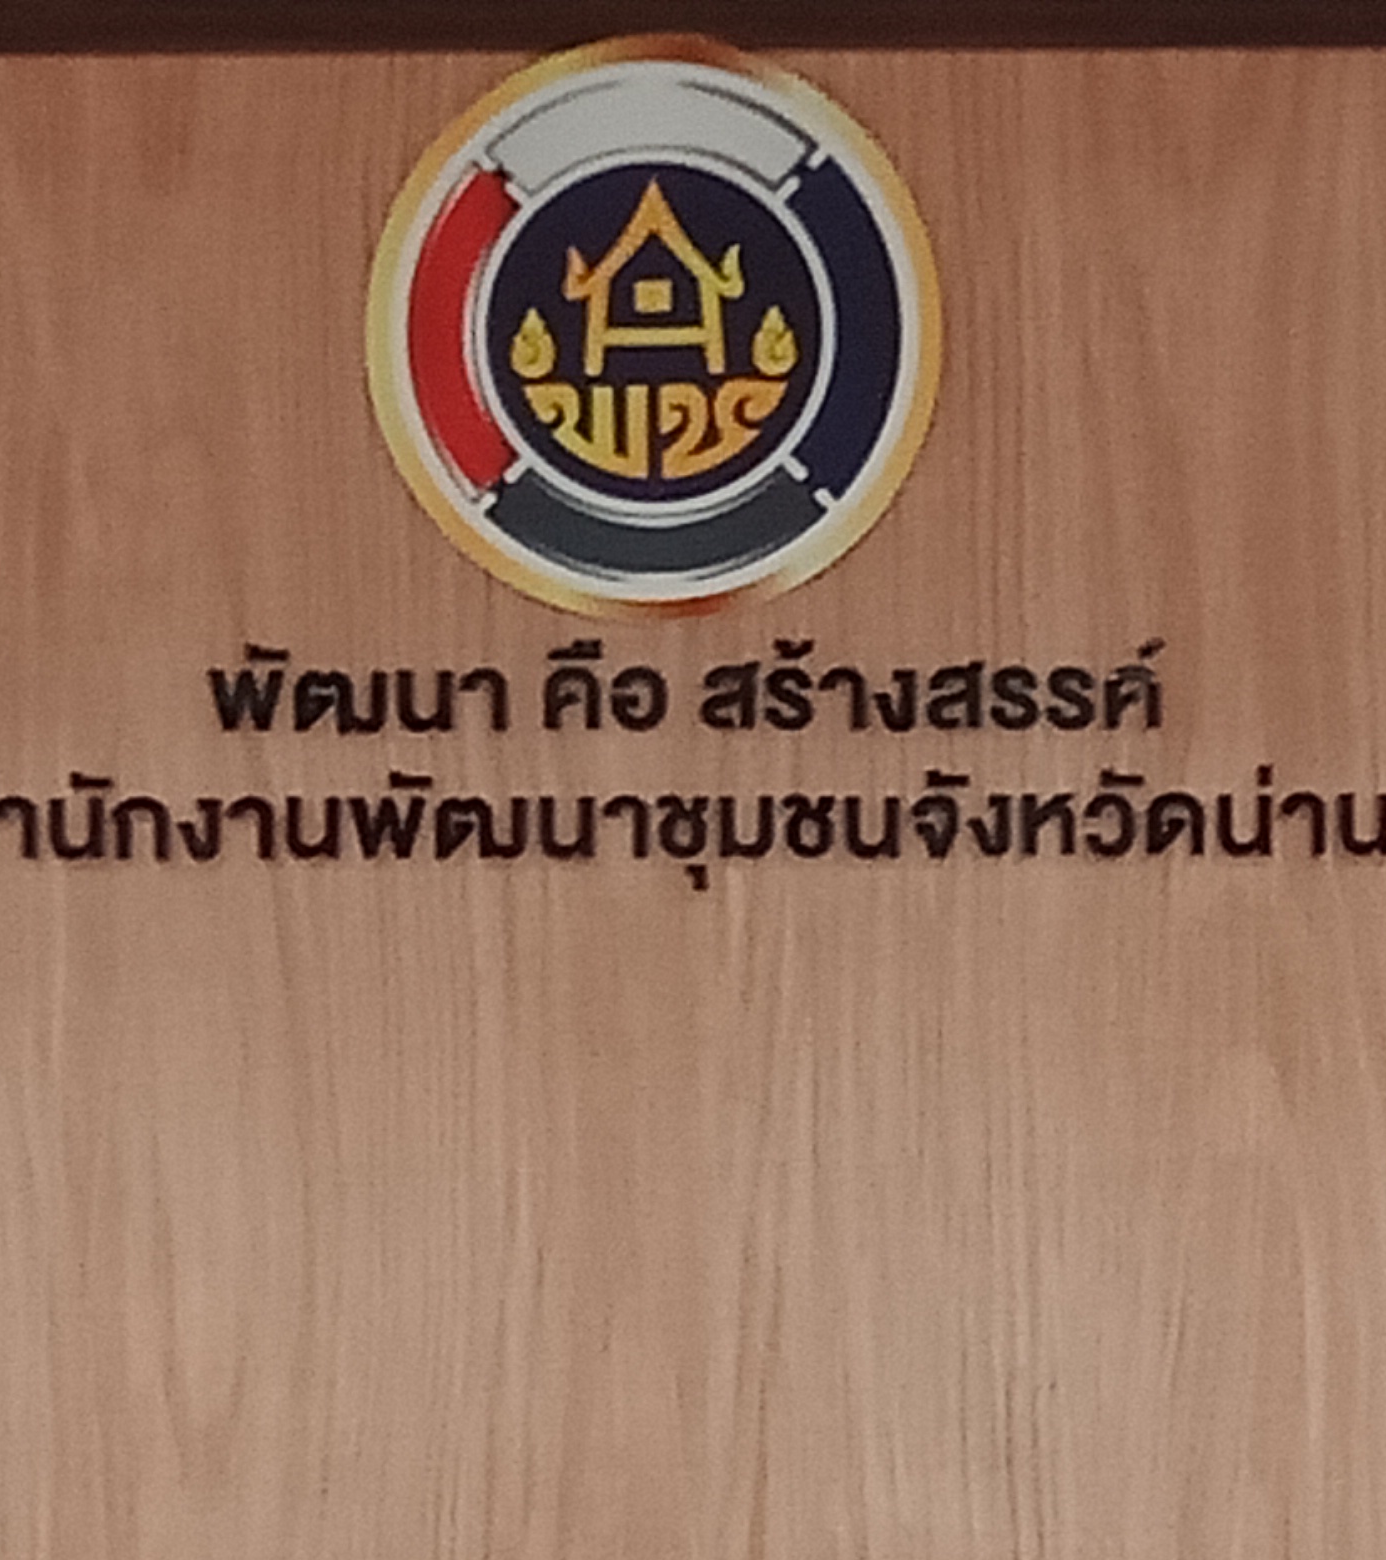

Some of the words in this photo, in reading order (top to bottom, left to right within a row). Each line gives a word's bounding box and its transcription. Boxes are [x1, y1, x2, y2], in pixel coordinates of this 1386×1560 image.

[207, 642, 510, 734] พัฒนา
[542, 638, 669, 732] คือ
[698, 637, 1166, 733] สร้างสรรค์
